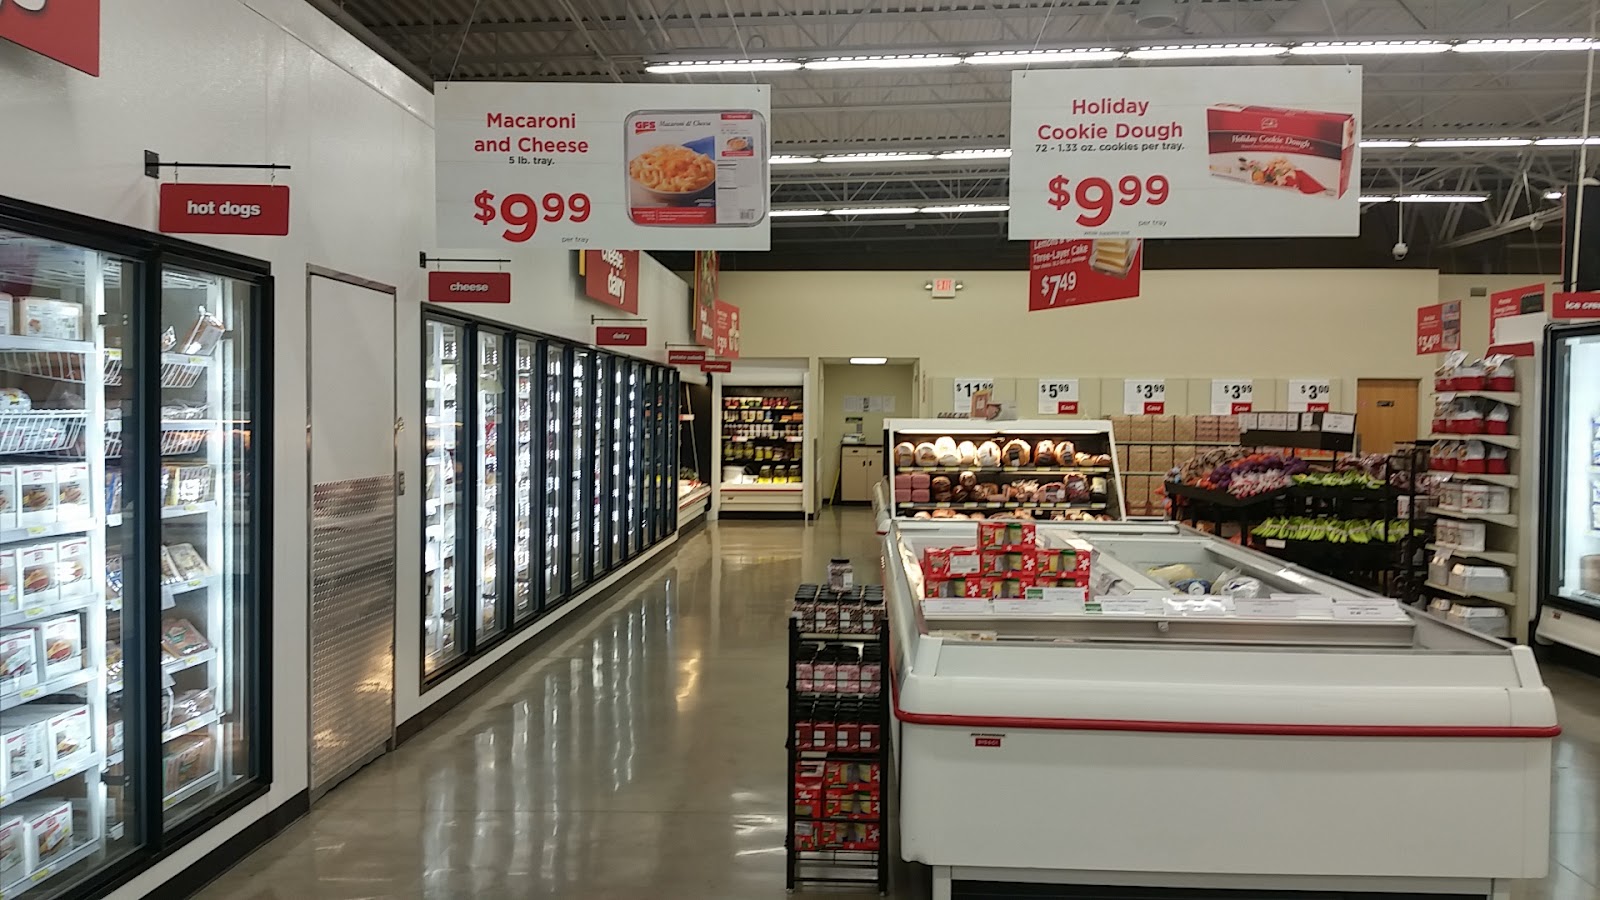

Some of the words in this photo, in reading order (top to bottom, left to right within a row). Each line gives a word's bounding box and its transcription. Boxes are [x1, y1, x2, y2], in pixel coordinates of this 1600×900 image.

[1072, 98, 1149, 117] Holiday
[487, 112, 576, 129] Macaroni
[635, 121, 656, 129] GFS
[1037, 123, 1108, 141] Cookie
[1115, 121, 1183, 142] Dough
[474, 136, 511, 152] and
[517, 136, 589, 153] Cheese
[1035, 143, 1048, 152] 72
[1057, 143, 1078, 152] 1.33
[1080, 144, 1097, 152] oz.
[1099, 142, 1138, 152] cookies
[1141, 143, 1160, 153] per
[1162, 142, 1185, 153] tray.
[509, 156, 515, 165] 5
[517, 155, 530, 165] lb.
[533, 156, 556, 167] tray.
[187, 200, 216, 216] hot
[218, 201, 261, 218] dogs
[1138, 219, 1150, 227] per
[1152, 219, 1167, 227] tray
[561, 236, 573, 244] per
[574, 236, 589, 244] tray
[1070, 243, 1089, 256] Cake
[449, 282, 489, 293] cheese
[608, 267, 626, 305] dairy
[1581, 301, 1600, 310] cre
[612, 332, 630, 341] dairy
